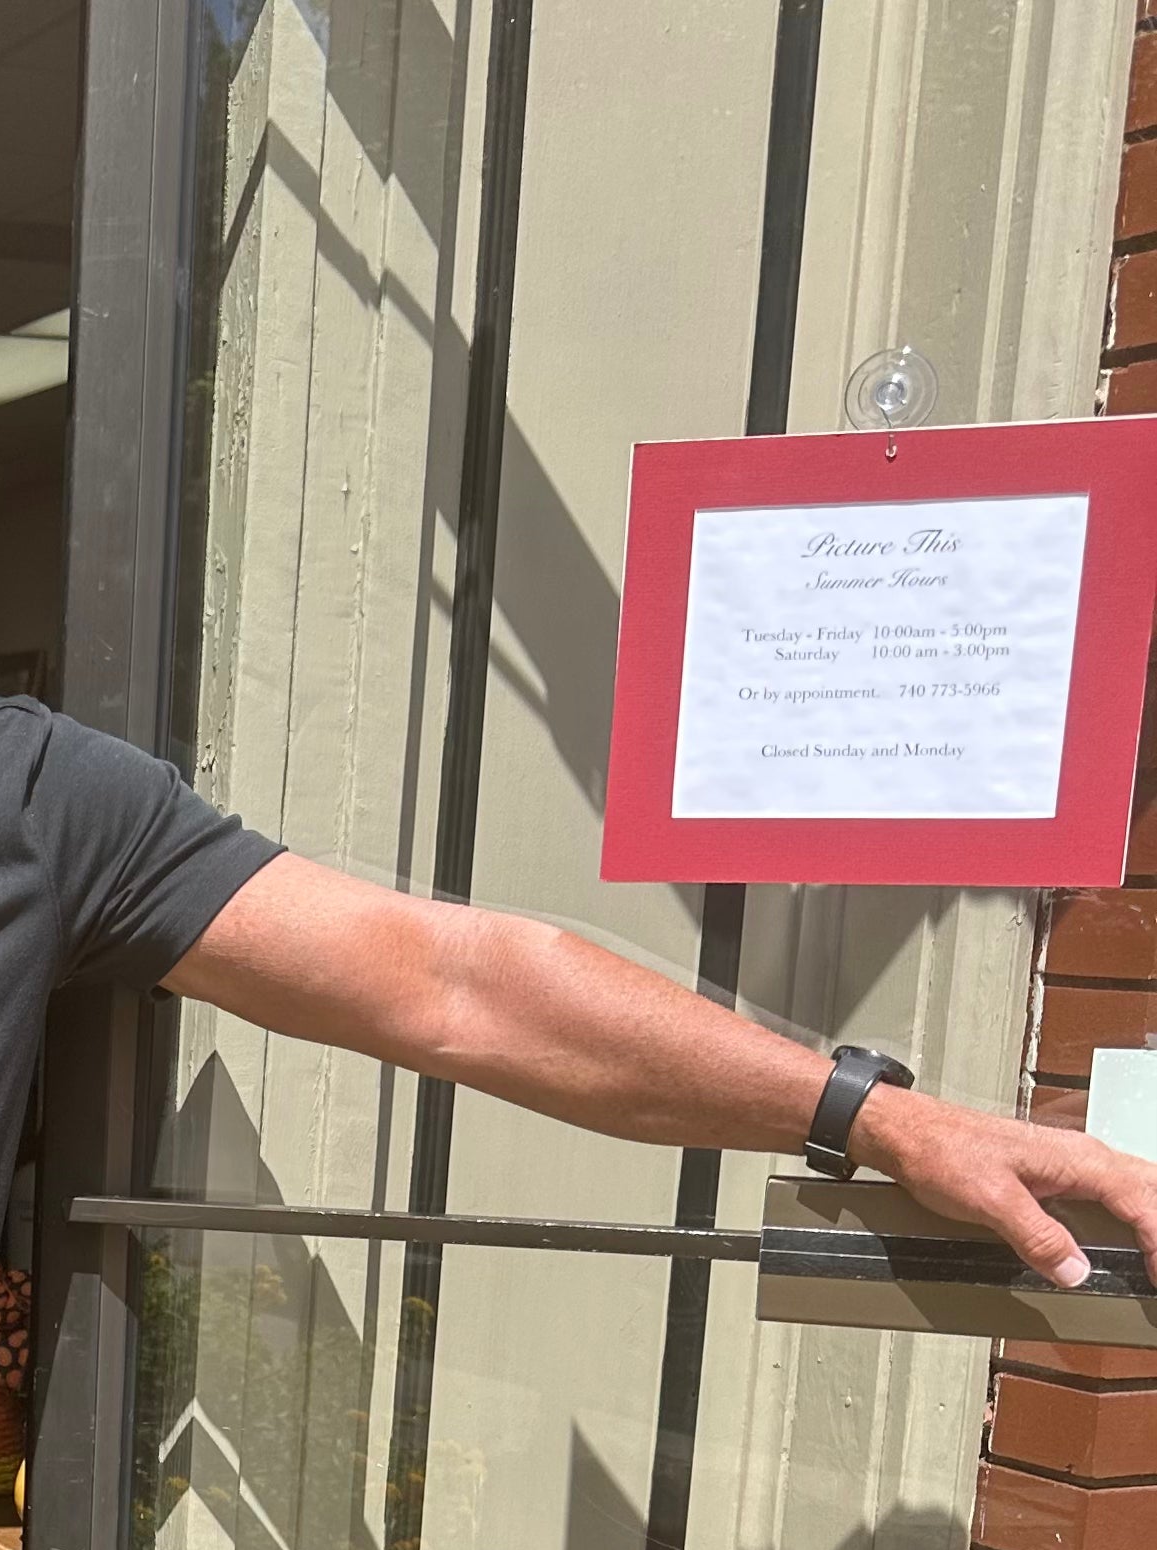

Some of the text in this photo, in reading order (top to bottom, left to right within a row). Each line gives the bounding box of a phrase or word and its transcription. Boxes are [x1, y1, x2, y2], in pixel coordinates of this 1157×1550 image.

[800, 529, 963, 559] Picture This
[805, 567, 948, 591] Summer Hours
[741, 628, 803, 645] Tuesday
[817, 626, 863, 644] Friday
[874, 624, 936, 639] 10:00am
[950, 622, 1007, 641] 5:00pm
[774, 646, 840, 663] Saturday
[872, 644, 911, 659] 10:00
[915, 647, 938, 658] am
[953, 642, 1010, 661] 3:00pm
[738, 687, 760, 700] Or
[763, 686, 781, 703] by
[899, 684, 926, 698] 740
[931, 682, 1001, 697] 773-5966
[761, 742, 965, 760] Closed Sunday and Monday
